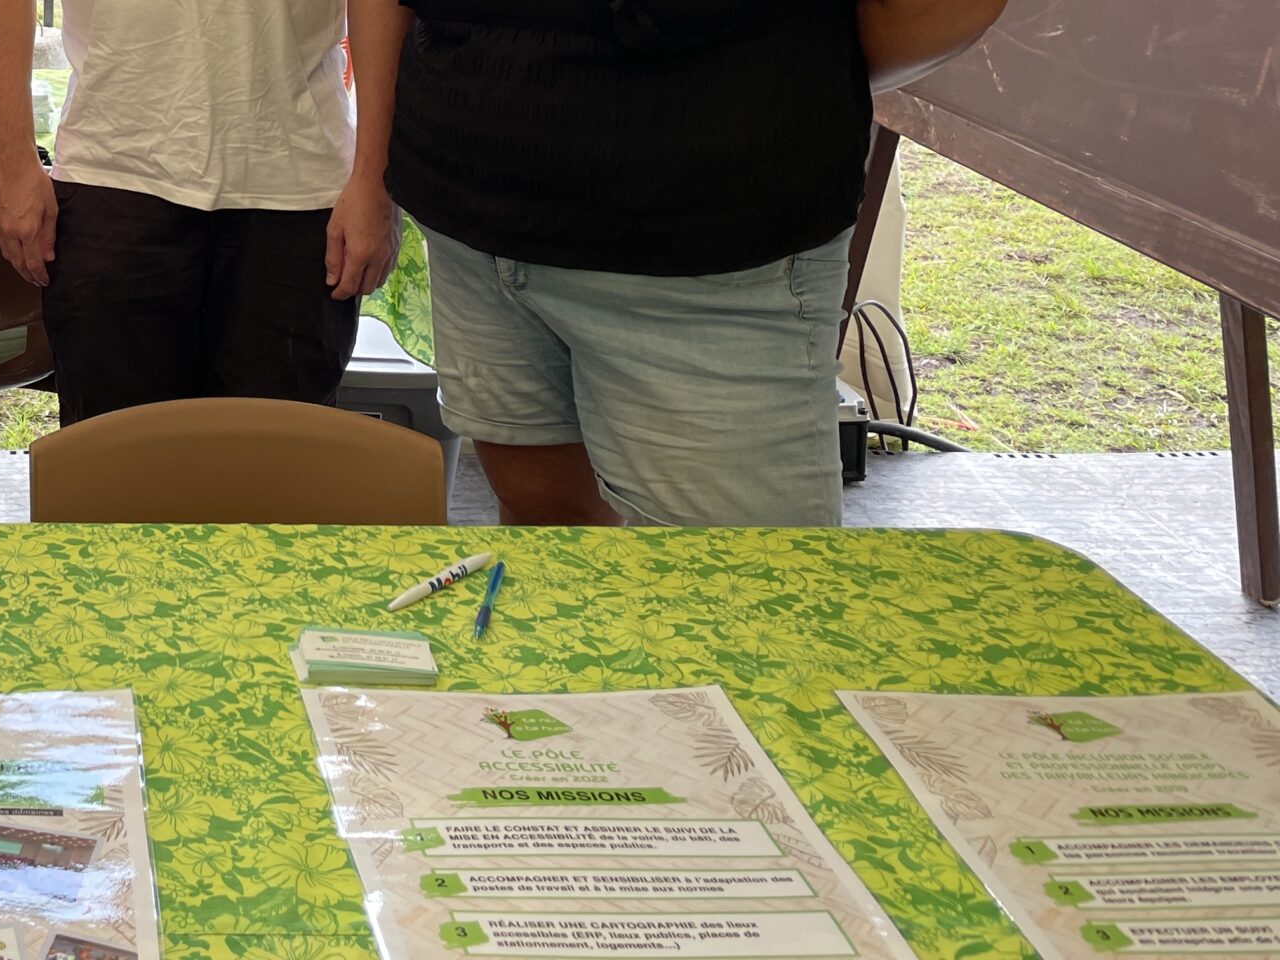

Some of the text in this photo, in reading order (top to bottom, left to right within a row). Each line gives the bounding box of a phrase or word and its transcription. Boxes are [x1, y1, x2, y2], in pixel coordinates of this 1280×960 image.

[501, 747, 585, 761] LE PÔLE
[478, 760, 622, 773] ACCESSIBILITÉ
[510, 774, 547, 783] Créer
[572, 774, 610, 783] 2022
[481, 788, 647, 804] NOS MISSIONS
[1088, 806, 1233, 819] NOS MISSIONS
[445, 825, 738, 835] FAIRE LE CONSTAT ET ASSURER LE SUIVI DE LA
[449, 833, 480, 841] MISE
[503, 832, 597, 841] ACCESSIBILITÉ
[671, 834, 688, 842] du
[719, 835, 741, 843] des
[452, 842, 515, 850] transports
[532, 841, 555, 849] des
[556, 842, 607, 850] espaces
[609, 842, 658, 851] publics.
[1024, 844, 1036, 855] 1
[434, 877, 448, 888] 2
[469, 875, 794, 886] ACCOMPAGNER ET SENSIBILISER à l'adaptation des
[535, 884, 575, 892] travail
[577, 884, 590, 892] et
[593, 883, 602, 892] à
[604, 884, 616, 892] la
[619, 884, 649, 892] mise
[677, 885, 725, 893] normes
[1057, 884, 1075, 896] 2
[487, 920, 759, 930] RÉALISER UNE CARTOGRAPHIE des lieux
[454, 926, 468, 938] 3
[492, 931, 569, 939] accessibles
[609, 931, 642, 940] lieux
[698, 931, 741, 940] places
[742, 930, 760, 938] de
[1095, 928, 1112, 942] 3
[496, 940, 594, 949] stationnement,
